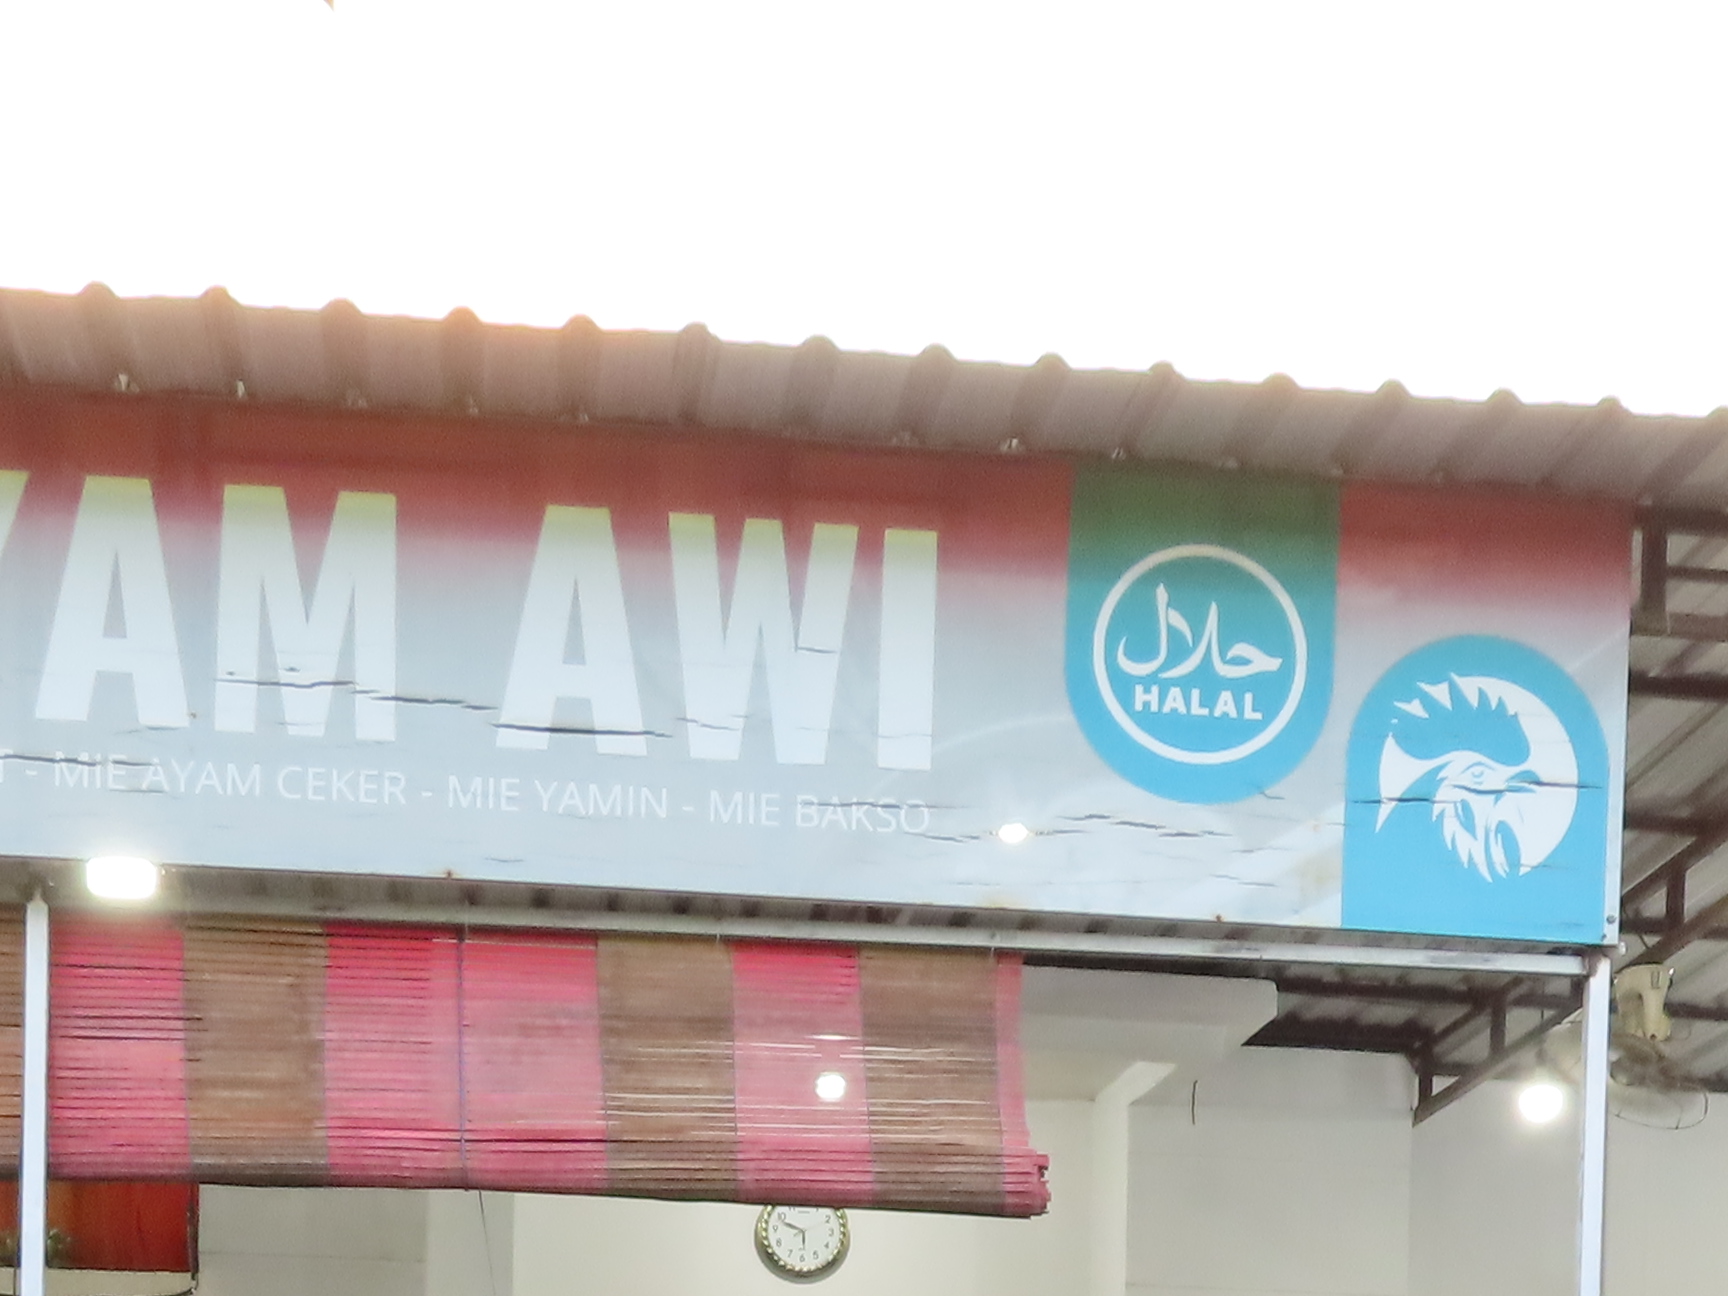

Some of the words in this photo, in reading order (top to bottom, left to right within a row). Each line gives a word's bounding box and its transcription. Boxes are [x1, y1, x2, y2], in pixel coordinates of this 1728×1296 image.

[495, 503, 939, 770] AWI
[1115, 581, 1283, 680] حلال
[1133, 683, 1264, 722] HALAL
[53, 751, 127, 791] MIE
[142, 758, 262, 798] AYAM
[276, 766, 407, 805] CEKER
[447, 775, 521, 812] MIE
[533, 779, 668, 818] YAMIN
[709, 789, 781, 827] MIE
[795, 795, 931, 834] BAKSO
